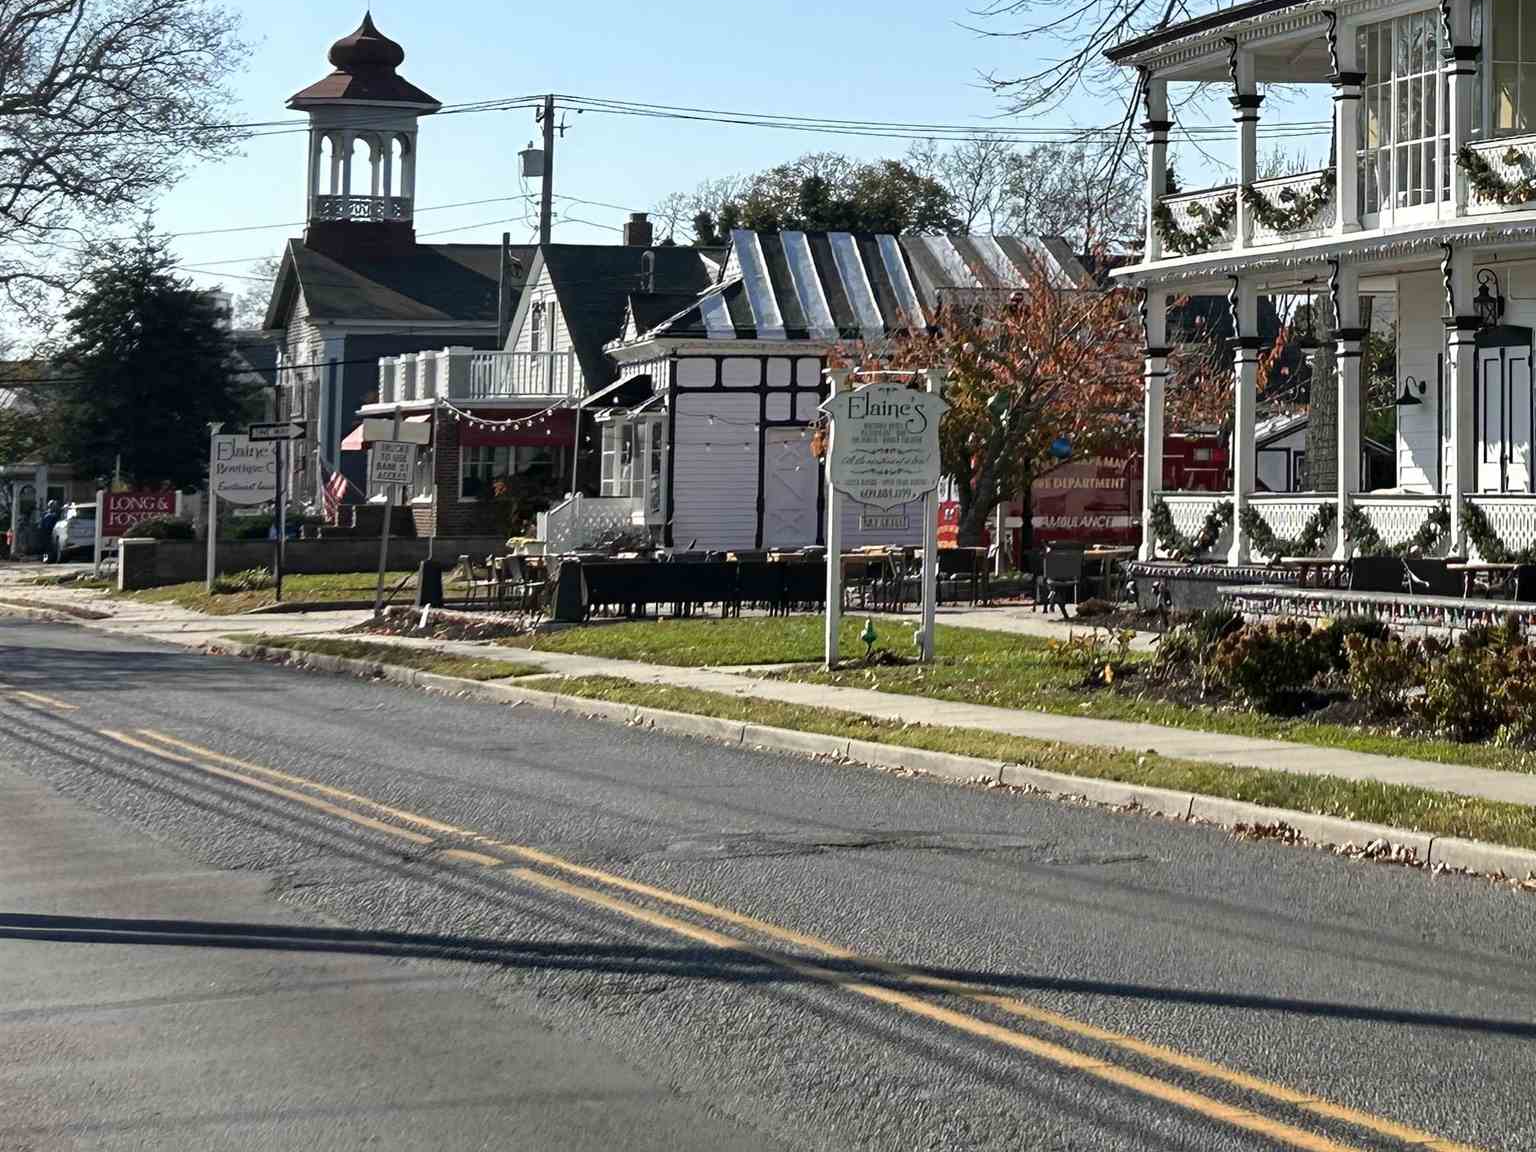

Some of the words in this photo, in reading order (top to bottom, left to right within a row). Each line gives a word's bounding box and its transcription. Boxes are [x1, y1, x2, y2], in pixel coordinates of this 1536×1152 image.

[848, 392, 927, 434] Elaine's
[1053, 477, 1126, 488] DEPARTMENT
[110, 496, 156, 511] LONG
[157, 496, 169, 511] &
[1042, 516, 1112, 529] AMBULANCE
